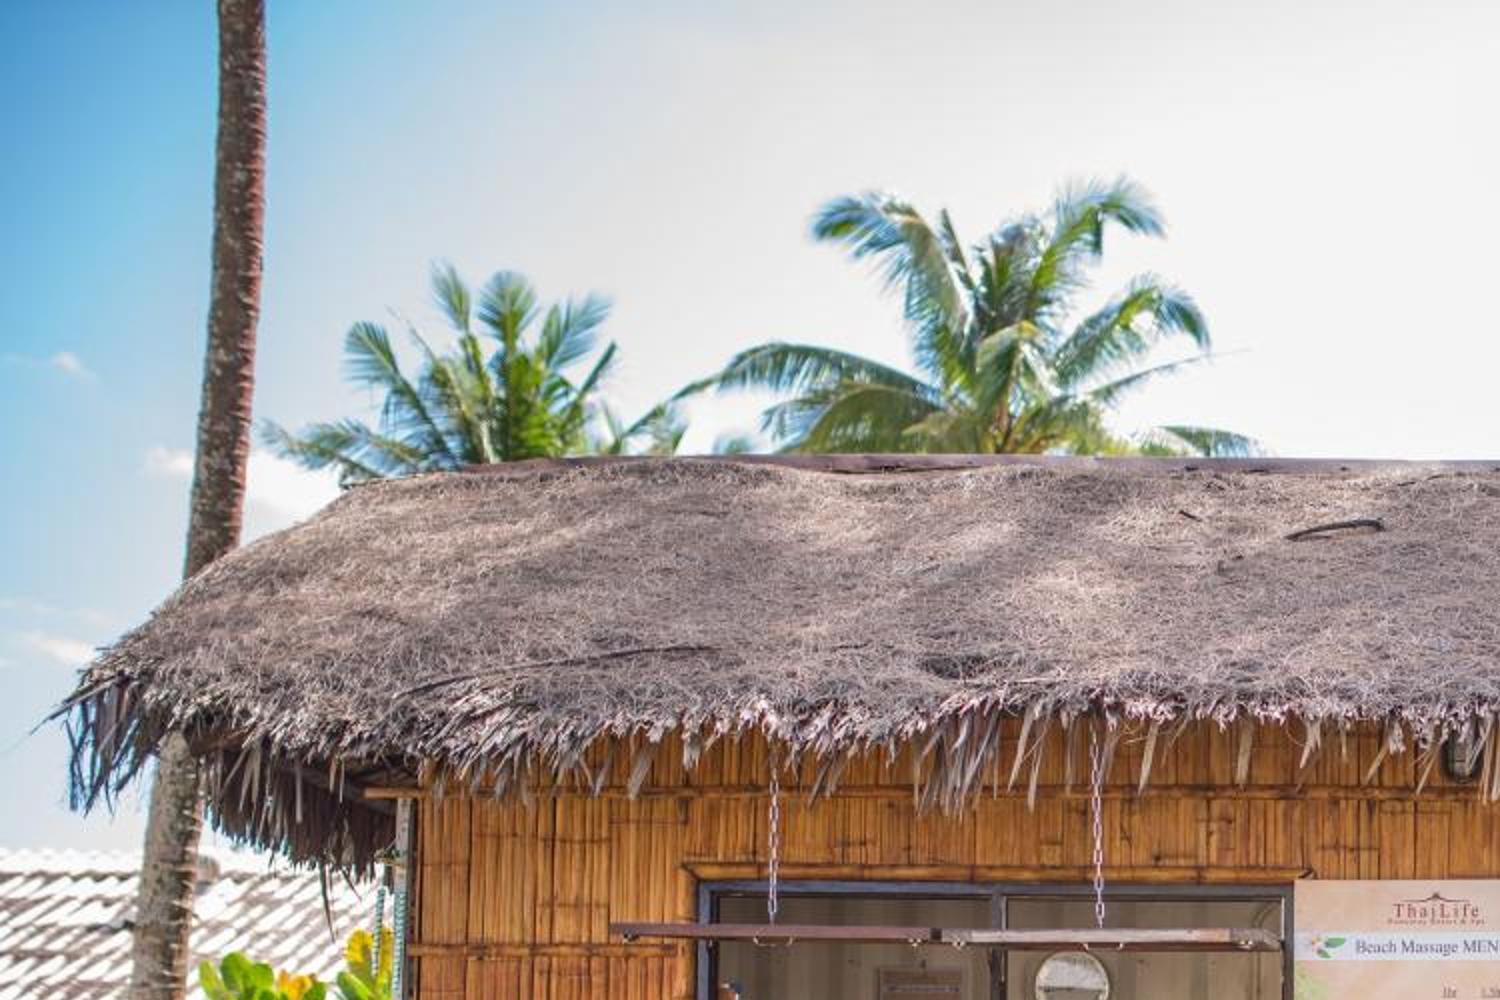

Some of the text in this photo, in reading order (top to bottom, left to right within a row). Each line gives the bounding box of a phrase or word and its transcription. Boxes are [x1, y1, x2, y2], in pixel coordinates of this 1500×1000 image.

[1392, 903, 1479, 919] ThaiLife
[1355, 940, 1396, 954] Beach
[1401, 940, 1458, 957] Massage
